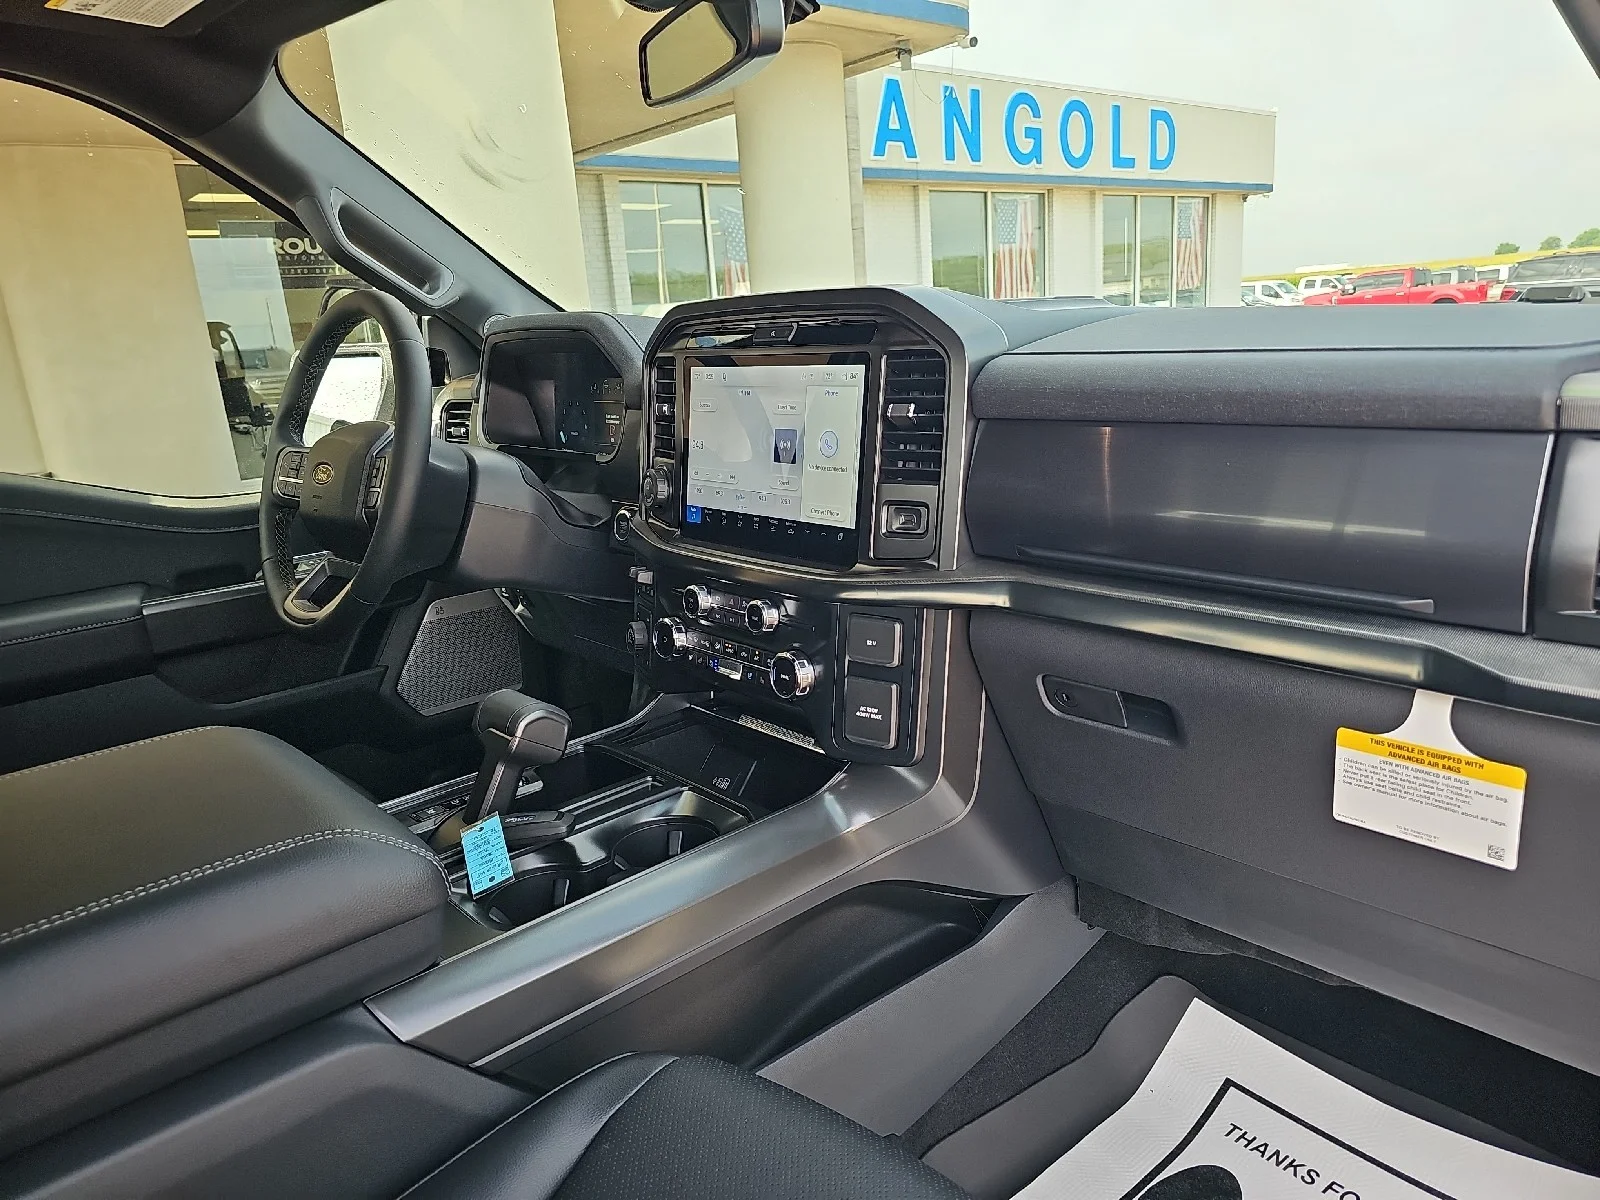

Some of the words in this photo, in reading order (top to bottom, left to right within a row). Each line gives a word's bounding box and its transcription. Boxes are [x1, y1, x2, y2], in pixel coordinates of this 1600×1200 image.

[871, 75, 1177, 171] ANGOLD
[1370, 738, 1385, 747] THIS
[1387, 742, 1416, 754] VEHICLE
[1426, 751, 1462, 765] EQUIPPED
[1464, 760, 1485, 770] WITH
[1388, 751, 1425, 765] ADVANCED
[1427, 760, 1440, 769] AIR
[1442, 763, 1462, 774] BAGS
[1343, 774, 1362, 784] Always
[1344, 757, 1366, 767] Children
[1413, 775, 1440, 787] seriously
[1442, 782, 1463, 792] injured
[1379, 759, 1393, 768] EVEN
[1395, 763, 1409, 771] WITH
[1411, 767, 1441, 779] ADVANCED
[1454, 777, 1470, 786] BAGS
[1388, 780, 1405, 790] facing
[1400, 777, 1417, 785] safest
[1419, 782, 1434, 791] place
[1354, 782, 1375, 792] owner's
[1377, 788, 1397, 798] manual
[1425, 801, 1460, 814] information
[1461, 811, 1479, 819] about
[1224, 1123, 1320, 1186] THANKS
